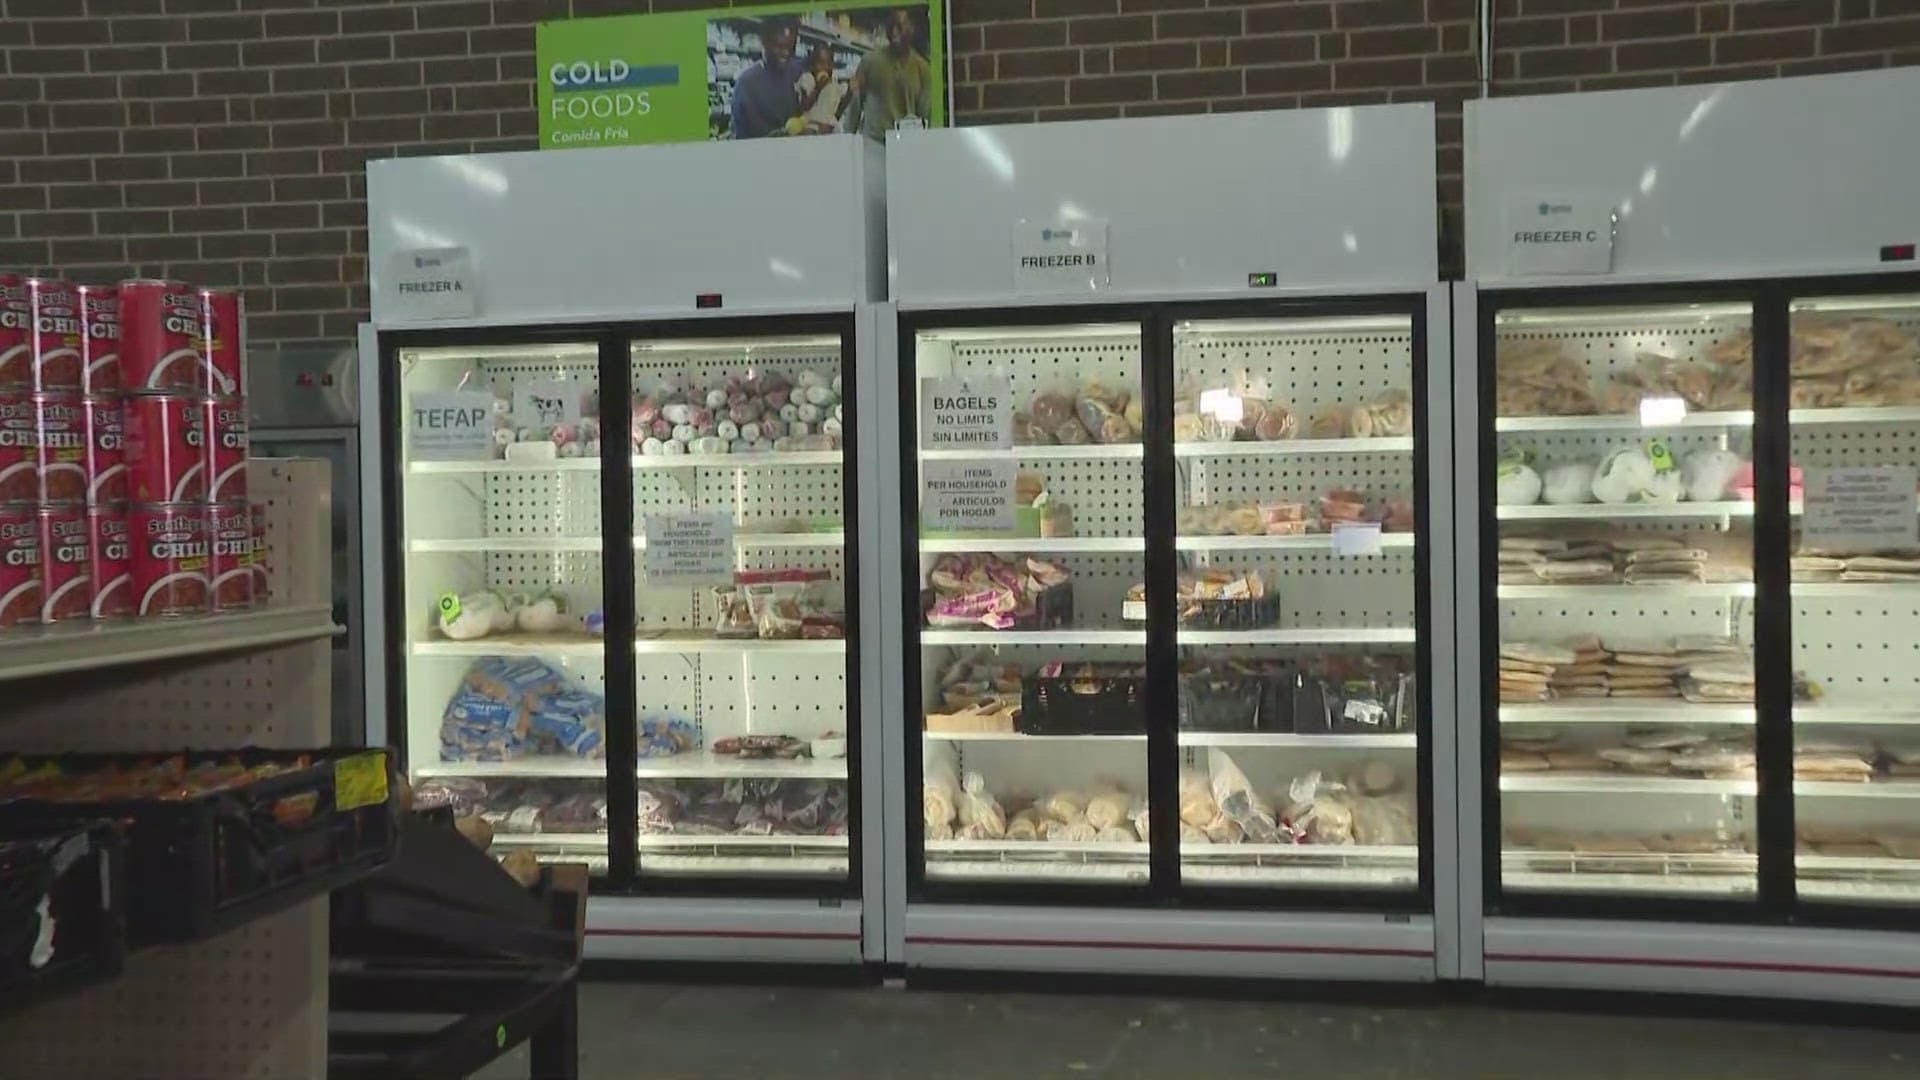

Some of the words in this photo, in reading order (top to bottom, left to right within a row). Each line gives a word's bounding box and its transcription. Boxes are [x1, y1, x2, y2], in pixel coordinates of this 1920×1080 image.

[550, 59, 629, 85] COLD
[551, 92, 650, 120] FOODS
[1514, 231, 1582, 243] FREEZER
[1586, 230, 1597, 241] C
[1021, 255, 1082, 268] FREEZER
[1086, 254, 1096, 265] B
[399, 281, 451, 294] FREEZER
[454, 281, 463, 291] A
[934, 397, 997, 410] BAGELS
[414, 408, 486, 428] TEFAP
[937, 415, 954, 425] NO
[957, 414, 994, 425] LIMITS
[933, 432, 951, 442] SIN
[954, 431, 999, 442] LIMITES
[964, 469, 993, 478] ITEMS
[928, 481, 946, 489] PER
[948, 479, 1007, 489] HOUSEHOLD
[952, 497, 1006, 506] ARTICULOS
[940, 509, 959, 518] POR
[961, 507, 996, 517] HOGAR
